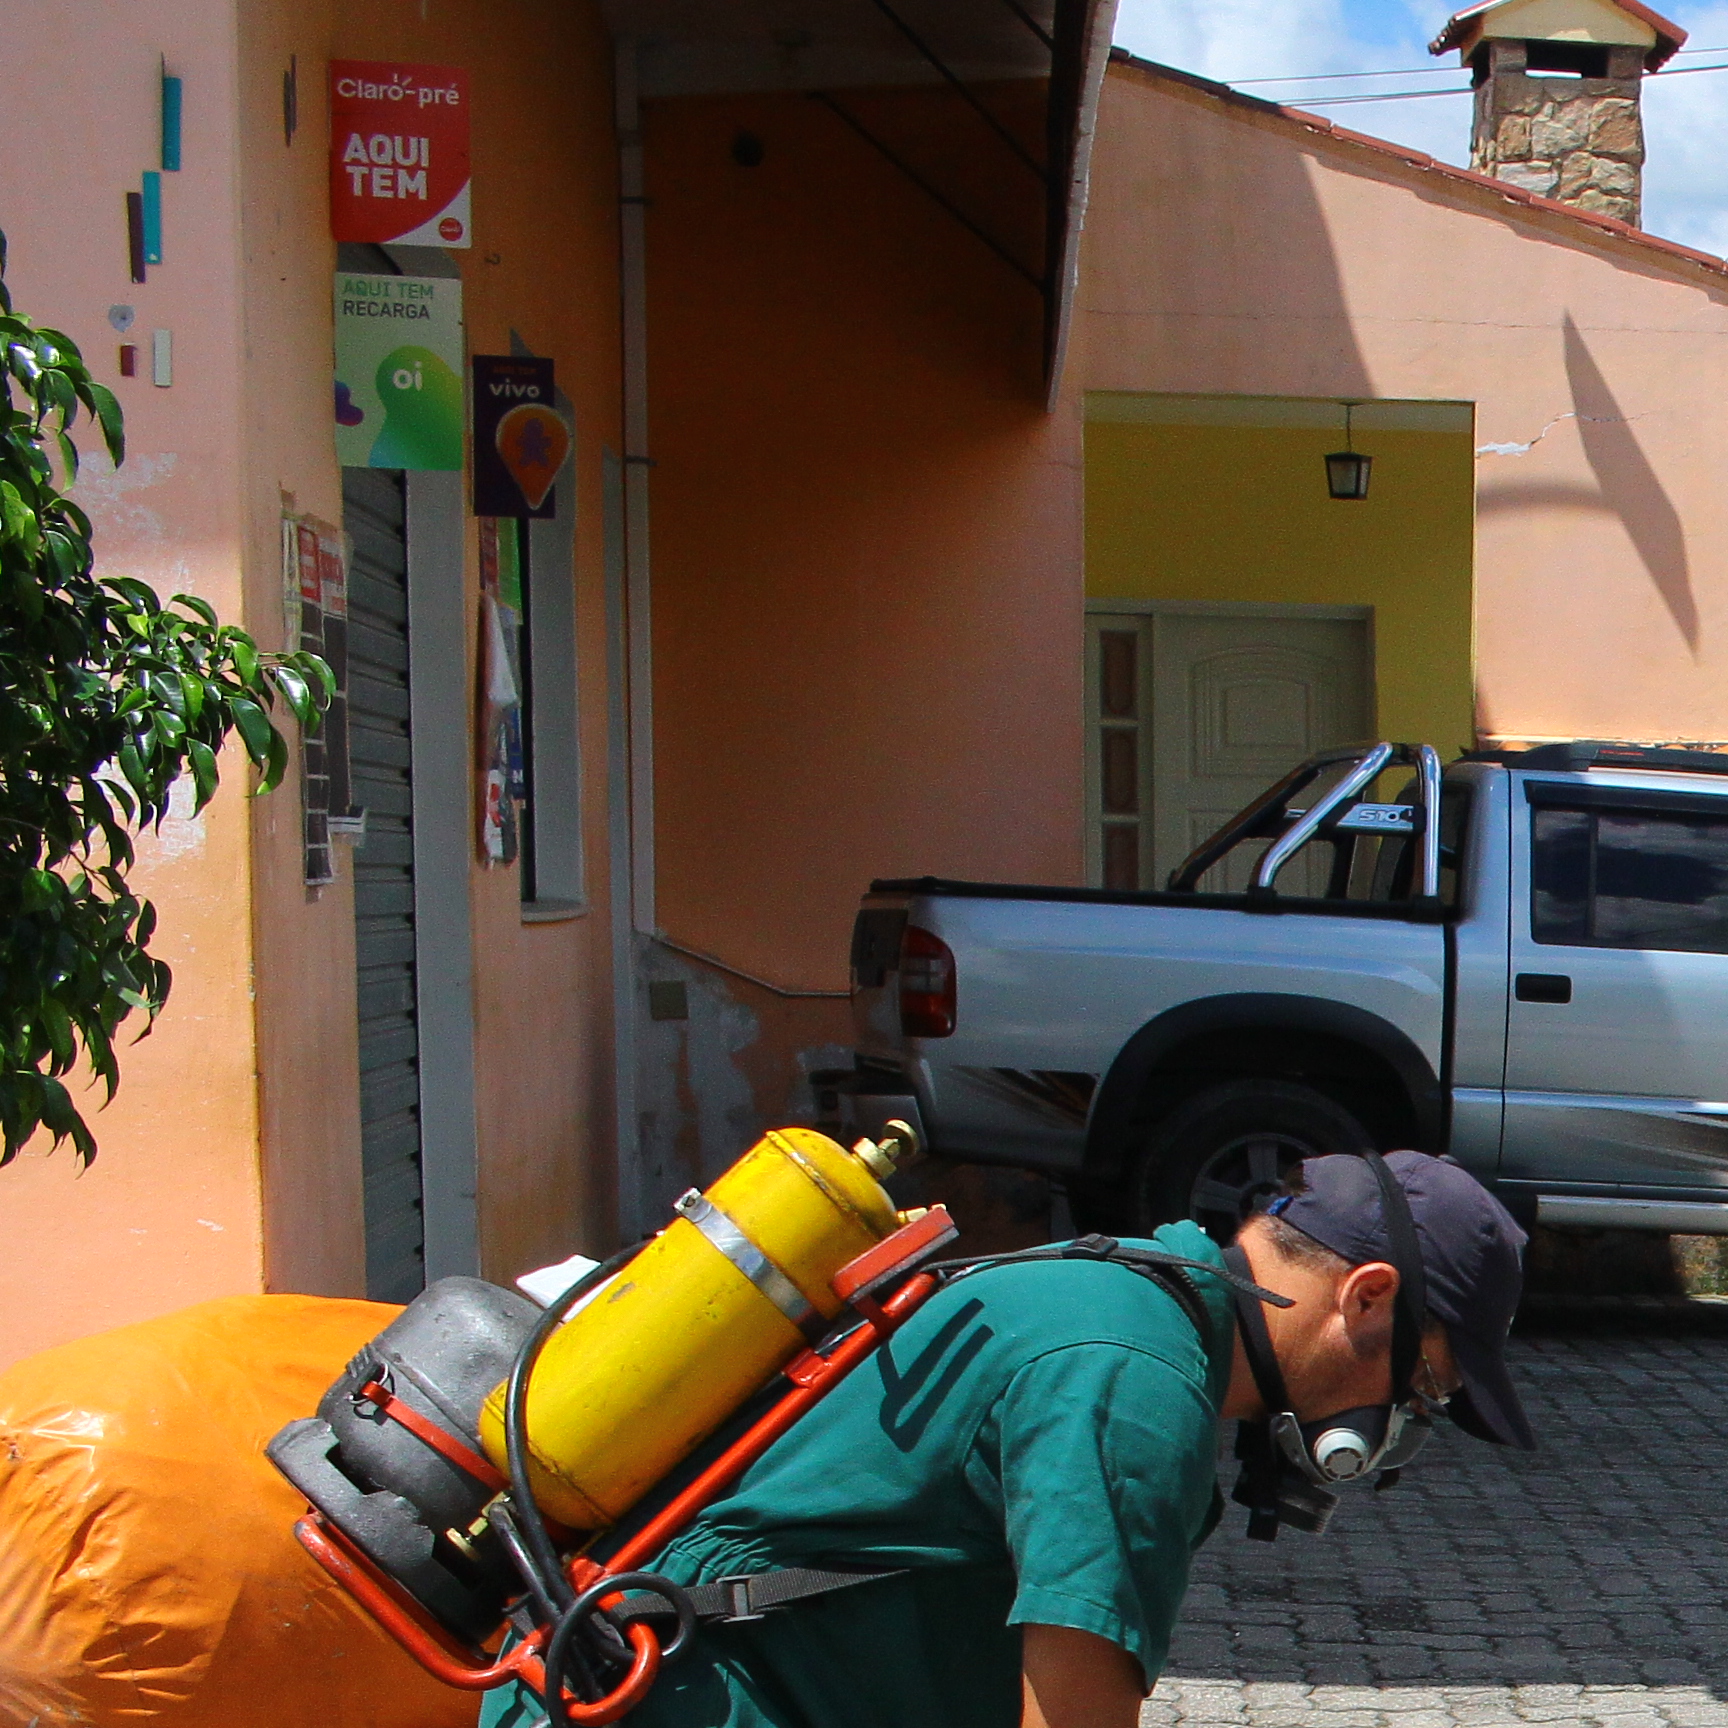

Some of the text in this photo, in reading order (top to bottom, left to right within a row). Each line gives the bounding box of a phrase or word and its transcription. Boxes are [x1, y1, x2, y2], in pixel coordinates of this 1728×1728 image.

[343, 132, 430, 168] AQUI
[346, 165, 428, 200] TEM
[342, 279, 434, 300] AQUI TEM
[343, 299, 430, 319] RECARGA
[392, 360, 423, 391] oi
[489, 378, 539, 398] vivo
[1359, 808, 1400, 823] S10
